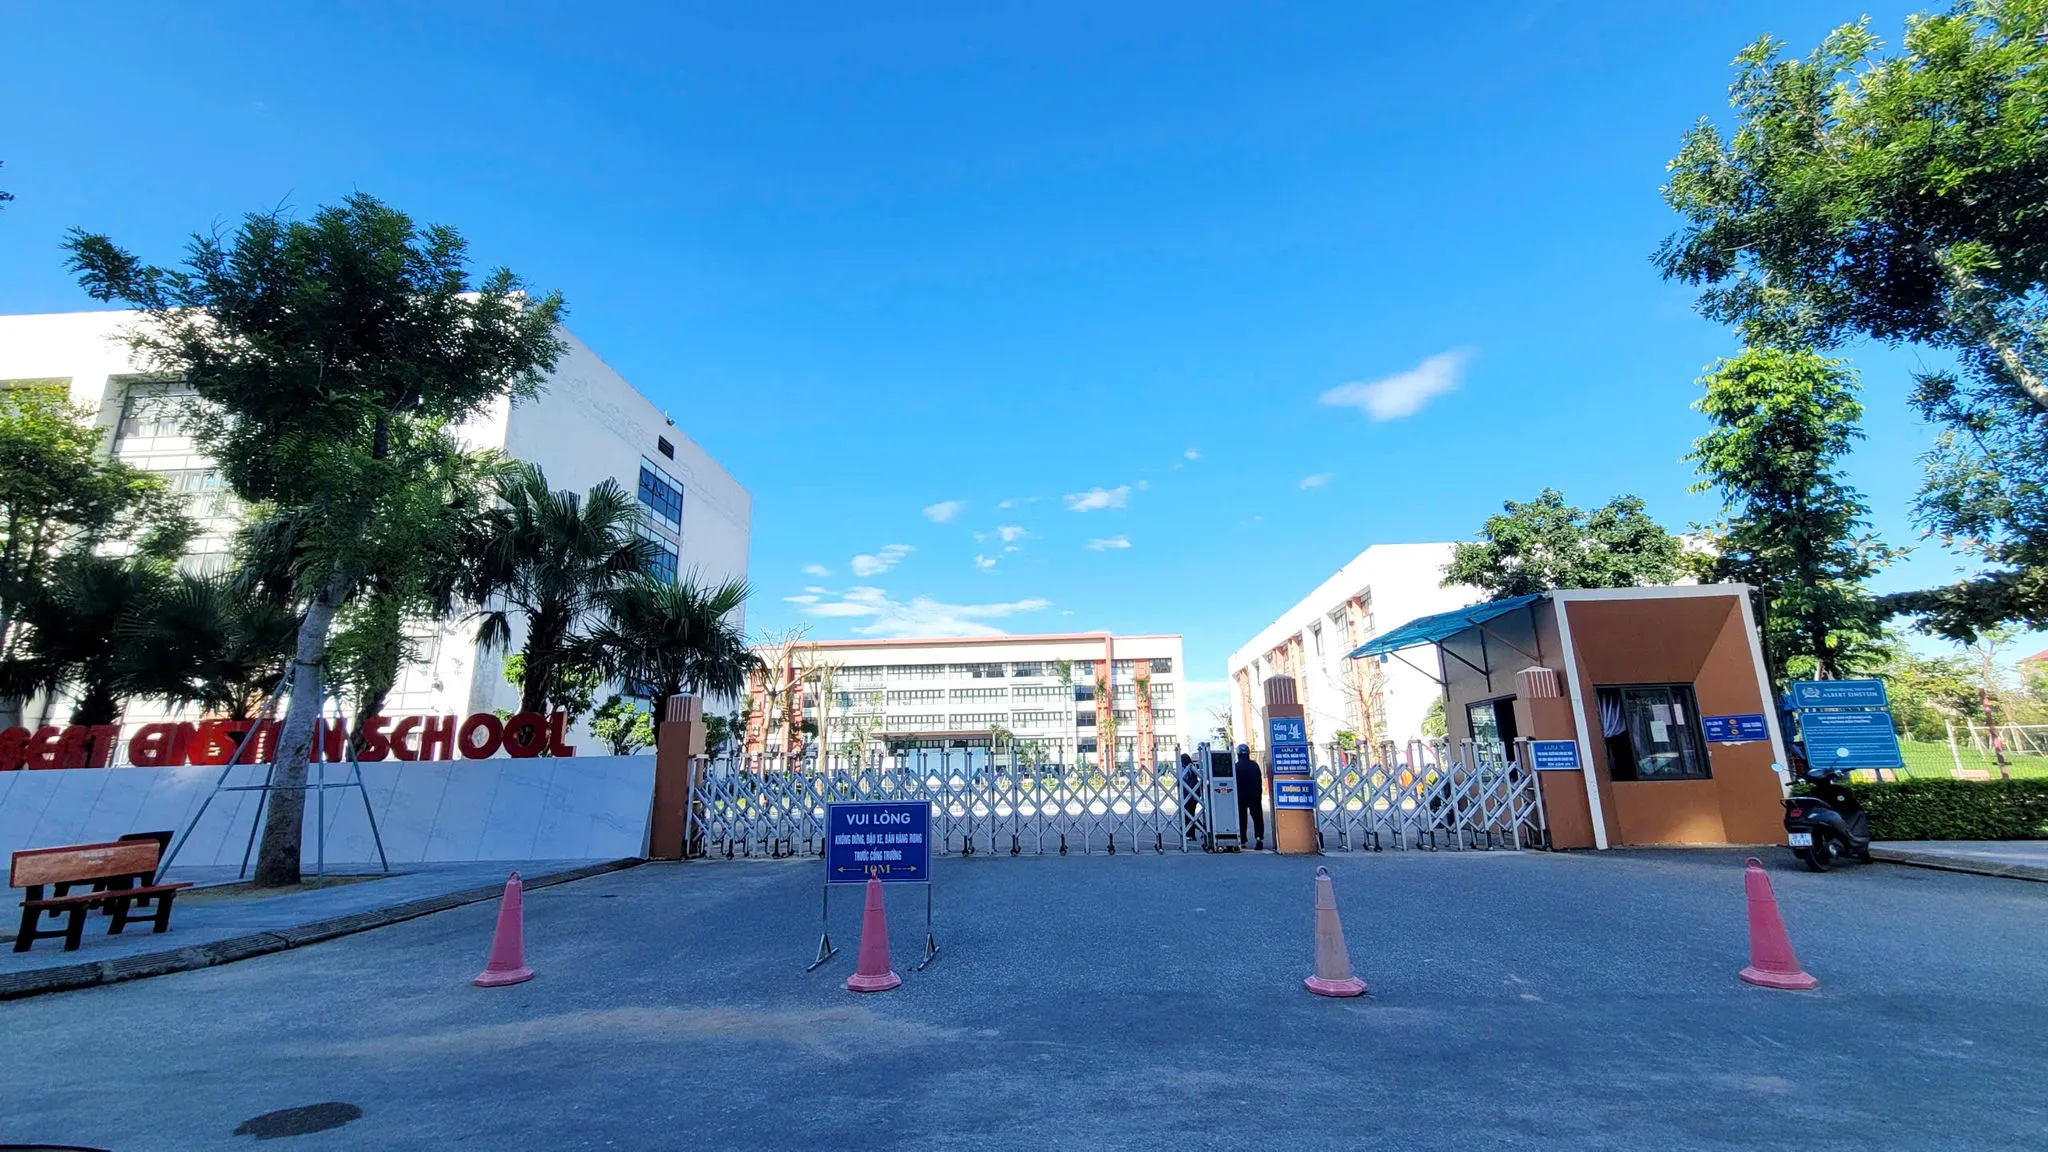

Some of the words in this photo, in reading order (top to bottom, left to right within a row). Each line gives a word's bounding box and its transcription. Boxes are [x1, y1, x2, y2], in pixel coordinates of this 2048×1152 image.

[357, 712, 576, 762] SCHOOL
[847, 814, 869, 825] VUI
[873, 810, 911, 825] LÒNG
